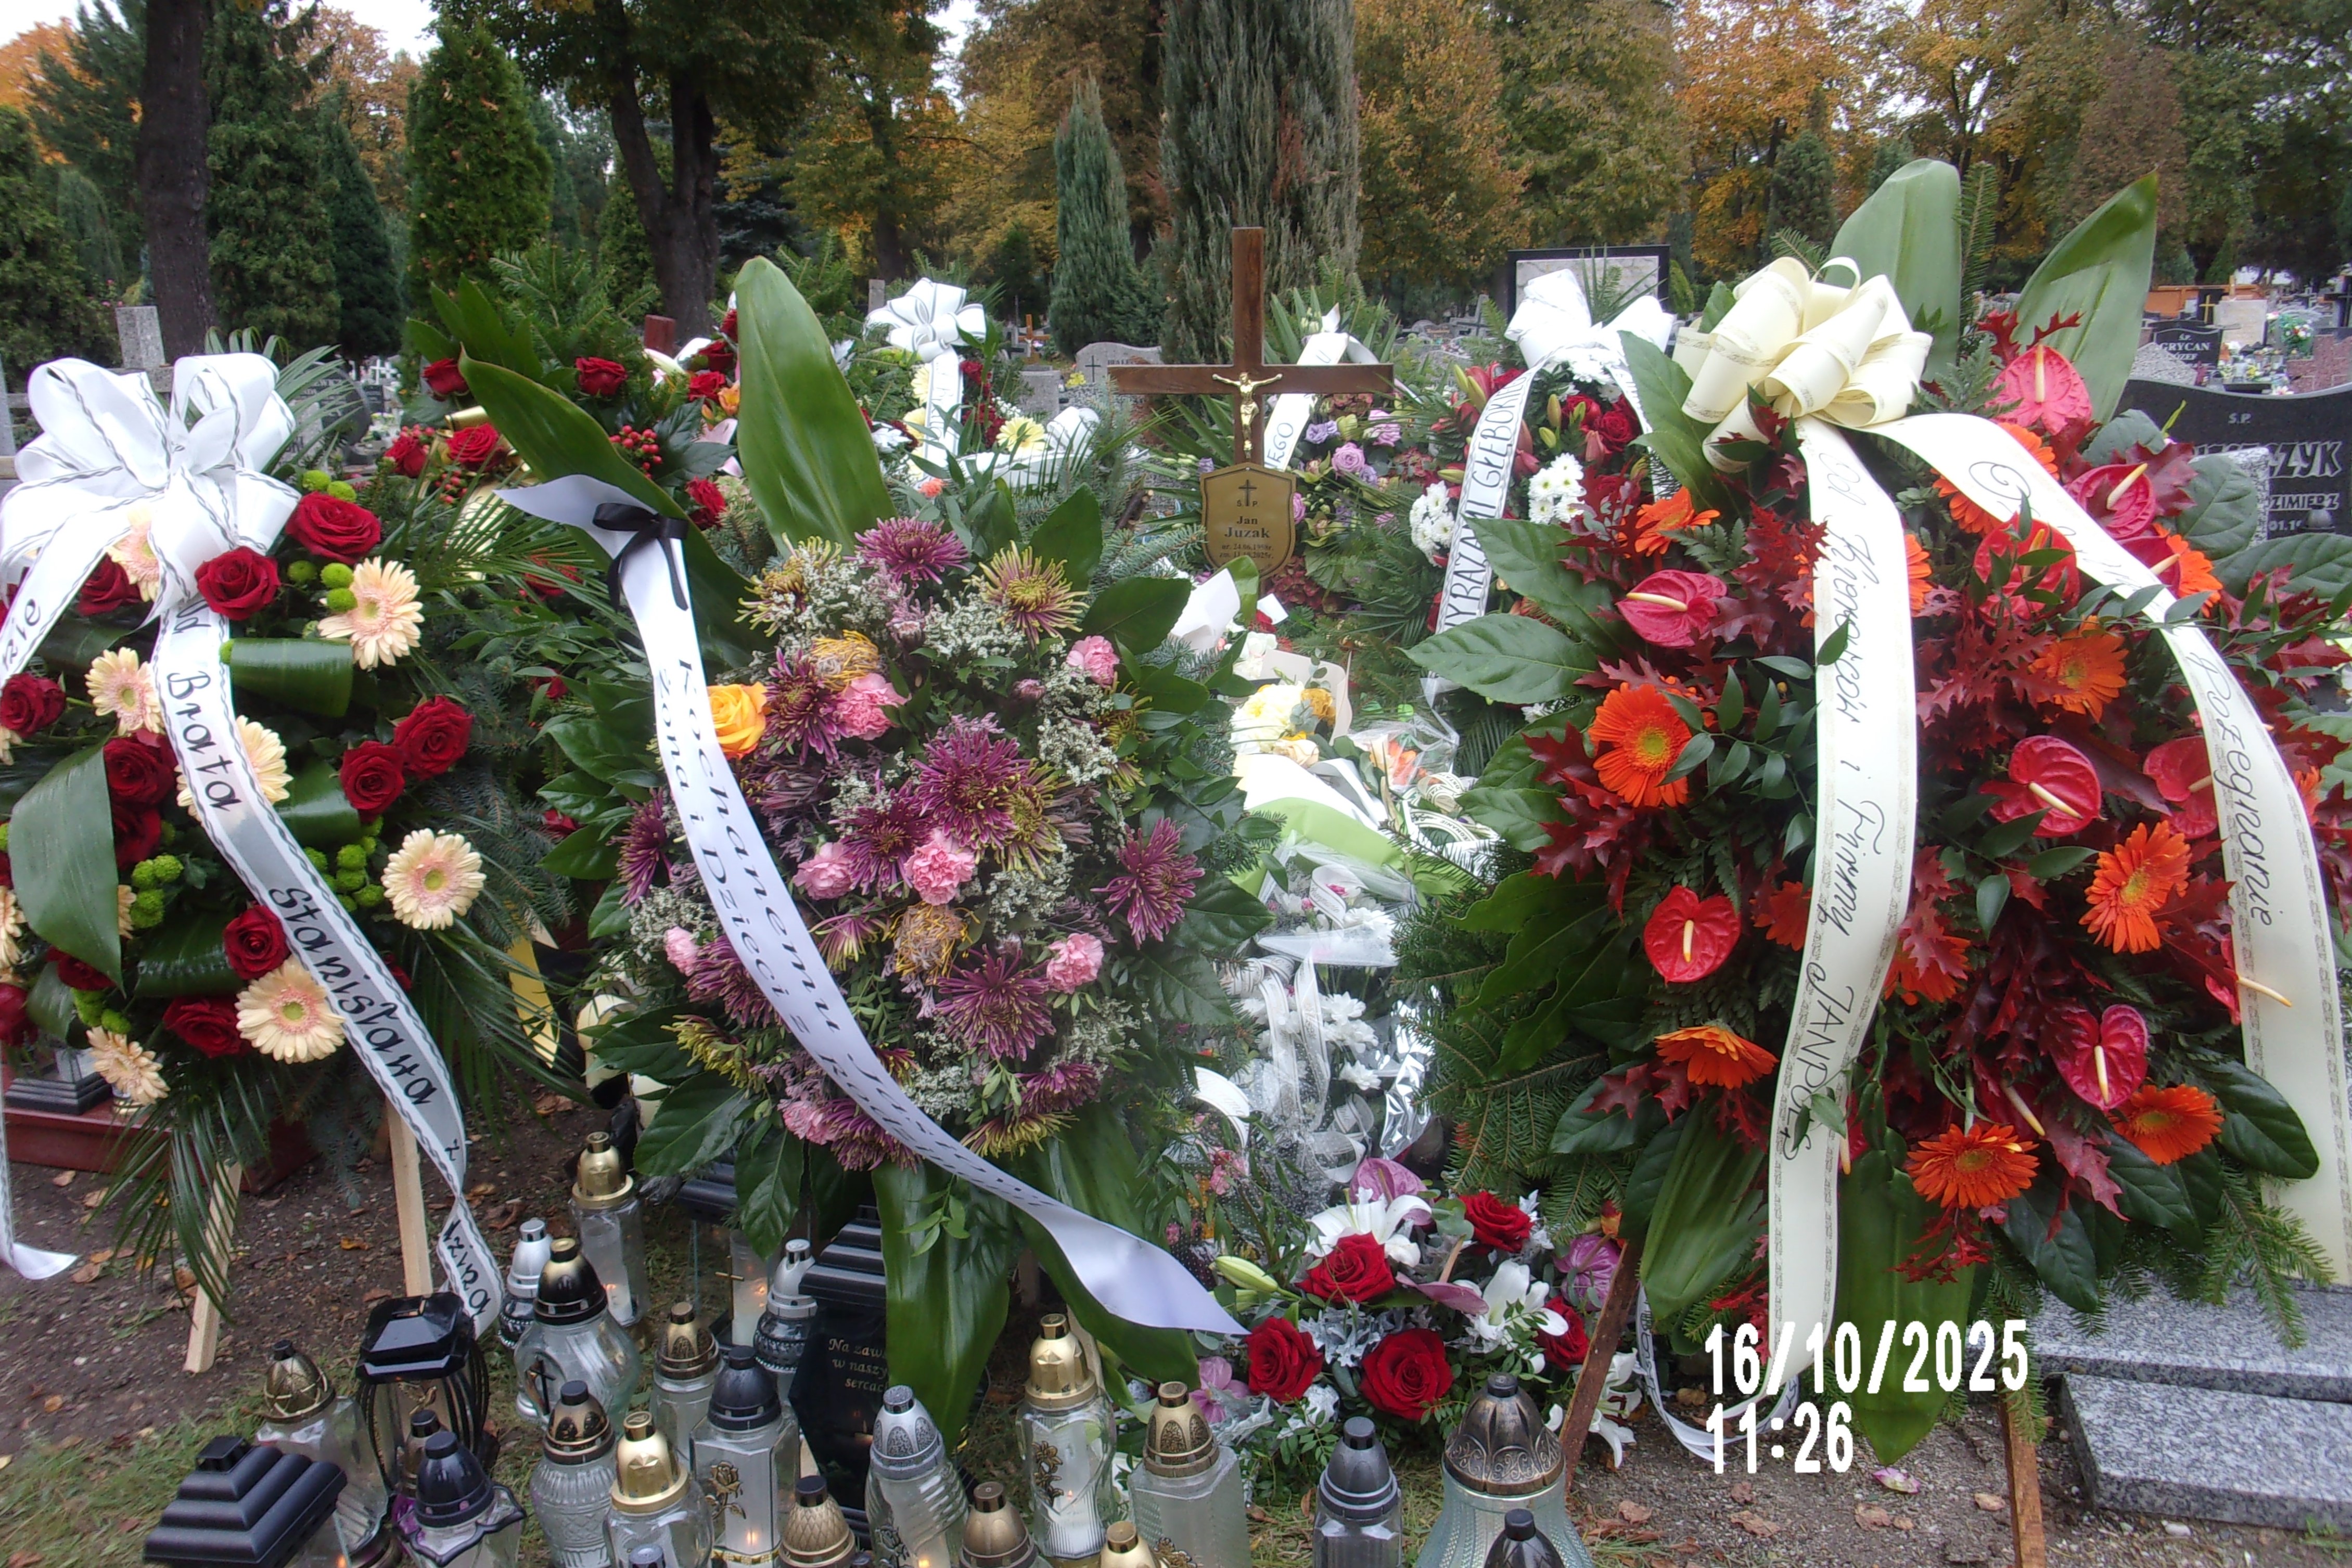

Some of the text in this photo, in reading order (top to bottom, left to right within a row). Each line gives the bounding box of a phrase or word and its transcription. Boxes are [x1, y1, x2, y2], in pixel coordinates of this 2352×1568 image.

[2172, 352, 2199, 360] ÓZEF
[1236, 516, 1258, 525] Jan
[1224, 527, 1270, 538] Juzak
[677, 658, 841, 1034] Kochanemu
[167, 670, 243, 812] Brata
[268, 886, 439, 1107] Stanisława
[699, 847, 790, 998] Dzieci
[828, 1338, 886, 1359] Na zaw
[849, 1361, 888, 1380] naszy
